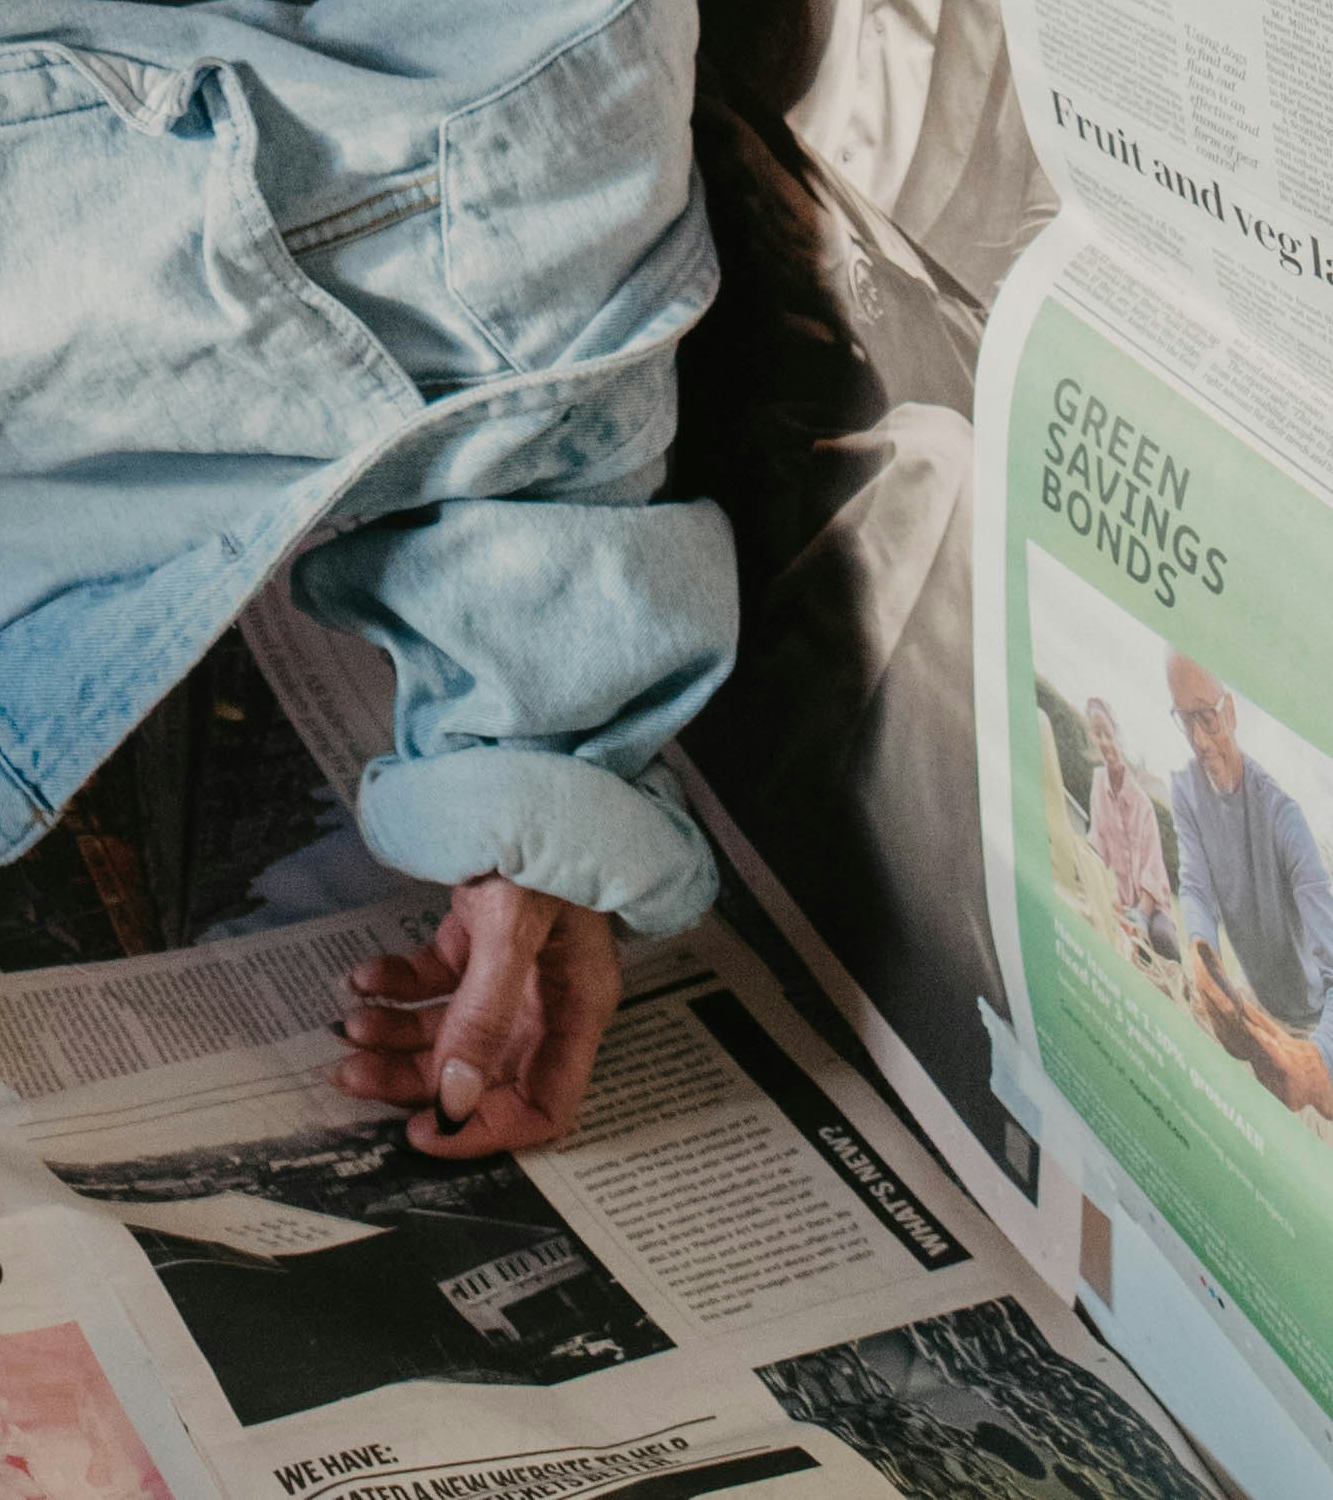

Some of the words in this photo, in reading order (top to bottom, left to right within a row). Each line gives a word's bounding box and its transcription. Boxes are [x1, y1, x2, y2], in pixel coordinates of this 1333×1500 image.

[1050, 87, 1146, 176] Fruit
[1153, 158, 1227, 225] and
[1231, 202, 1305, 279] veg
[1044, 421, 1229, 596] SAVINGS
[1052, 376, 1191, 513] GREEN
[1040, 465, 1180, 610] BONDS
[273, 1453, 327, 1497] WE
[325, 1442, 399, 1480] HAVE:
